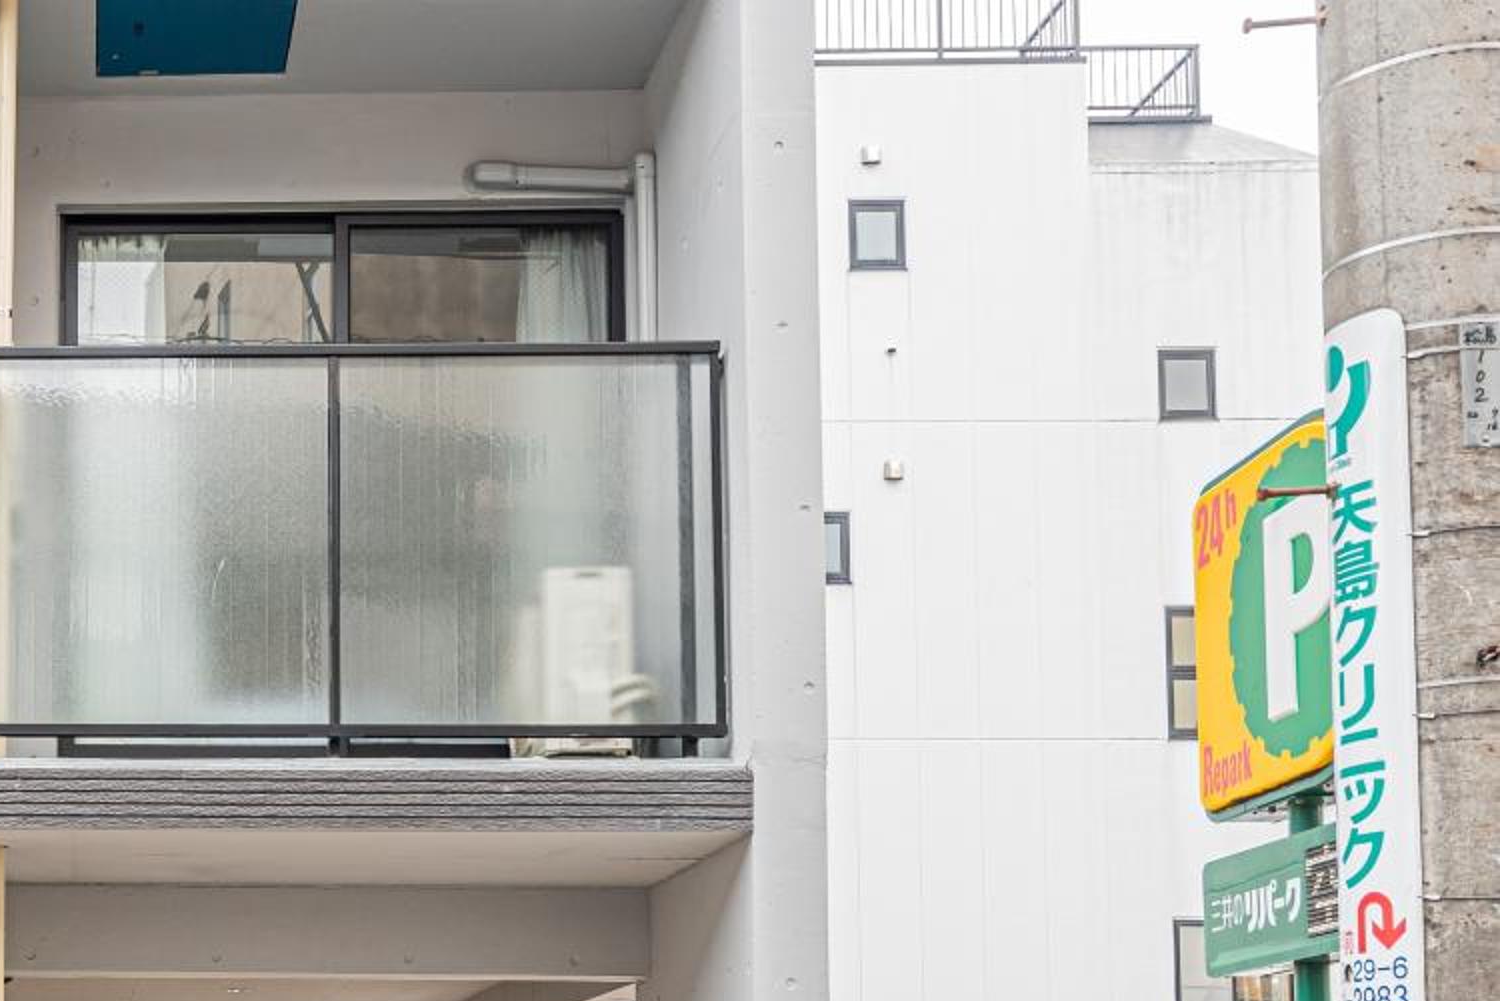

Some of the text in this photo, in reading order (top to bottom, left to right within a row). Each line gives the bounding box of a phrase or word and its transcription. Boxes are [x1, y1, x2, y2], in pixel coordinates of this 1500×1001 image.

[1262, 492, 1332, 722] P
[1203, 741, 1252, 796] Repark
[1211, 877, 1301, 933] 三井のリパーク
